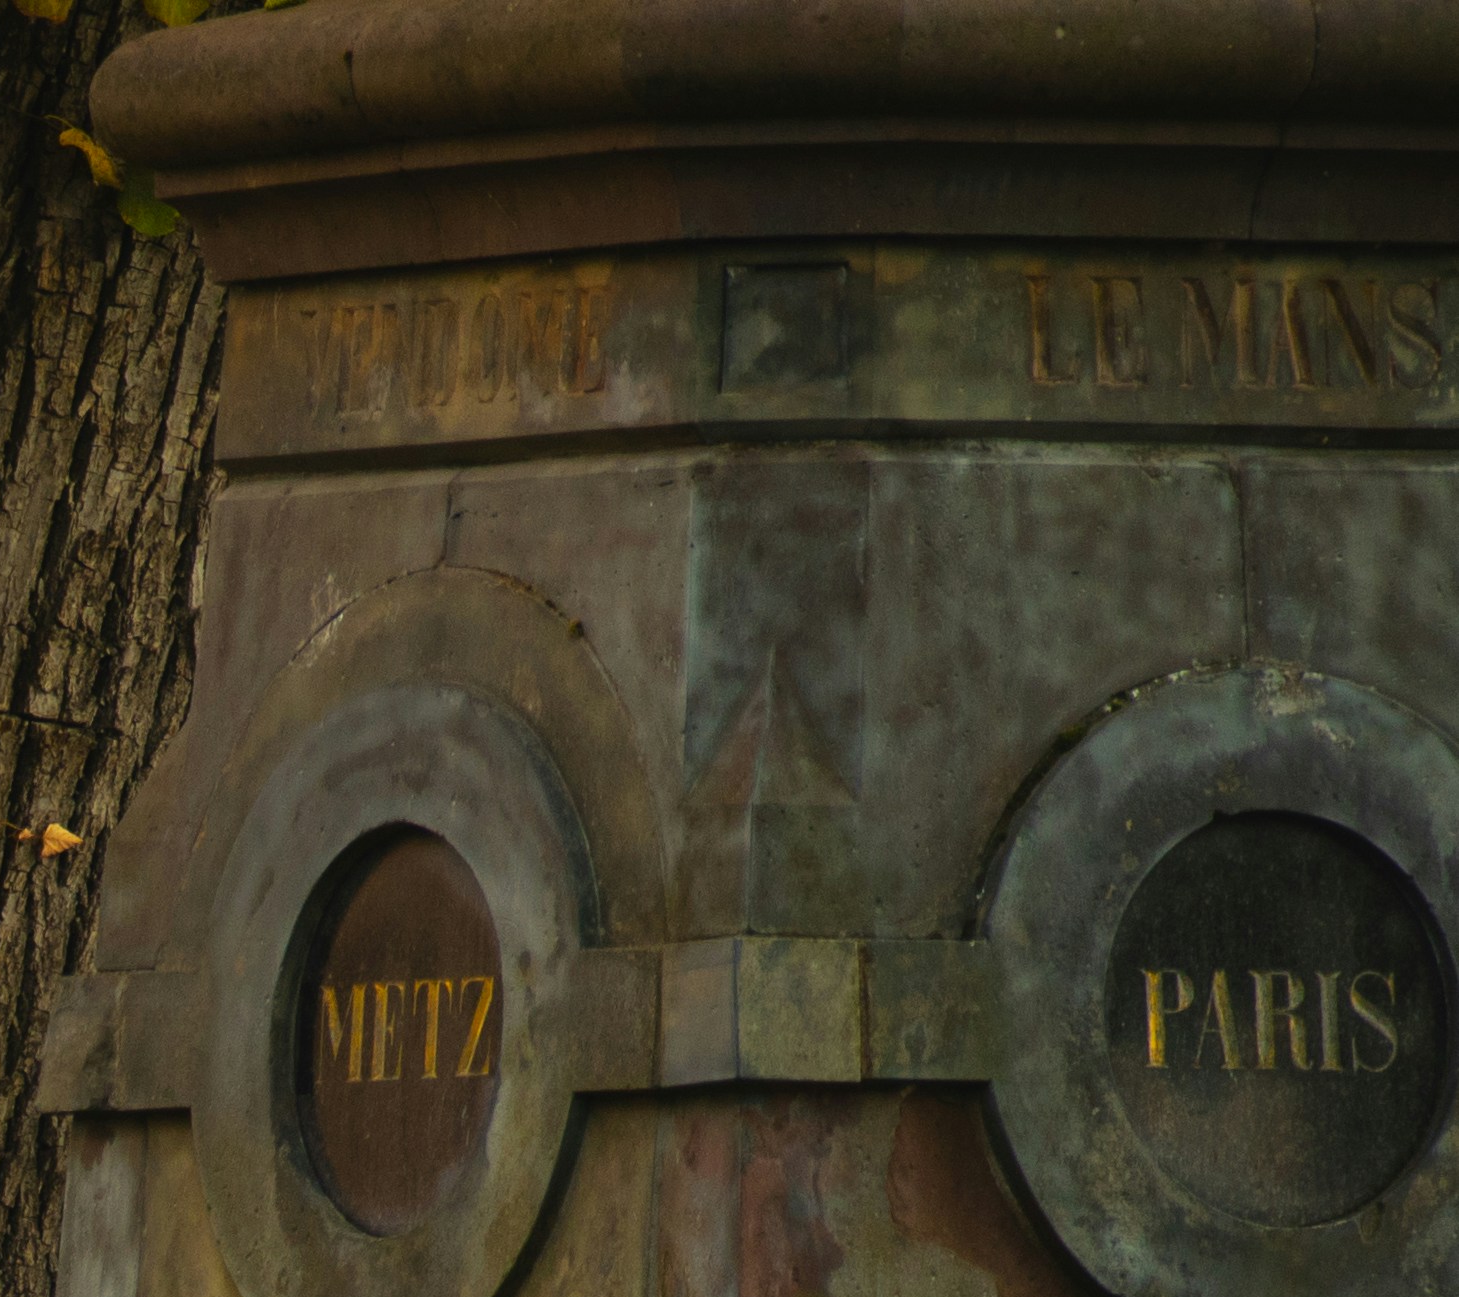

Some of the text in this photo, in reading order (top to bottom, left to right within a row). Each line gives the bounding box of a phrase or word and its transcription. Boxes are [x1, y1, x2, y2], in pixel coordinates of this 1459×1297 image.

[1024, 274, 1442, 390] LE MANS
[318, 972, 496, 1084] METZ
[1139, 968, 1400, 1073] PARIS
